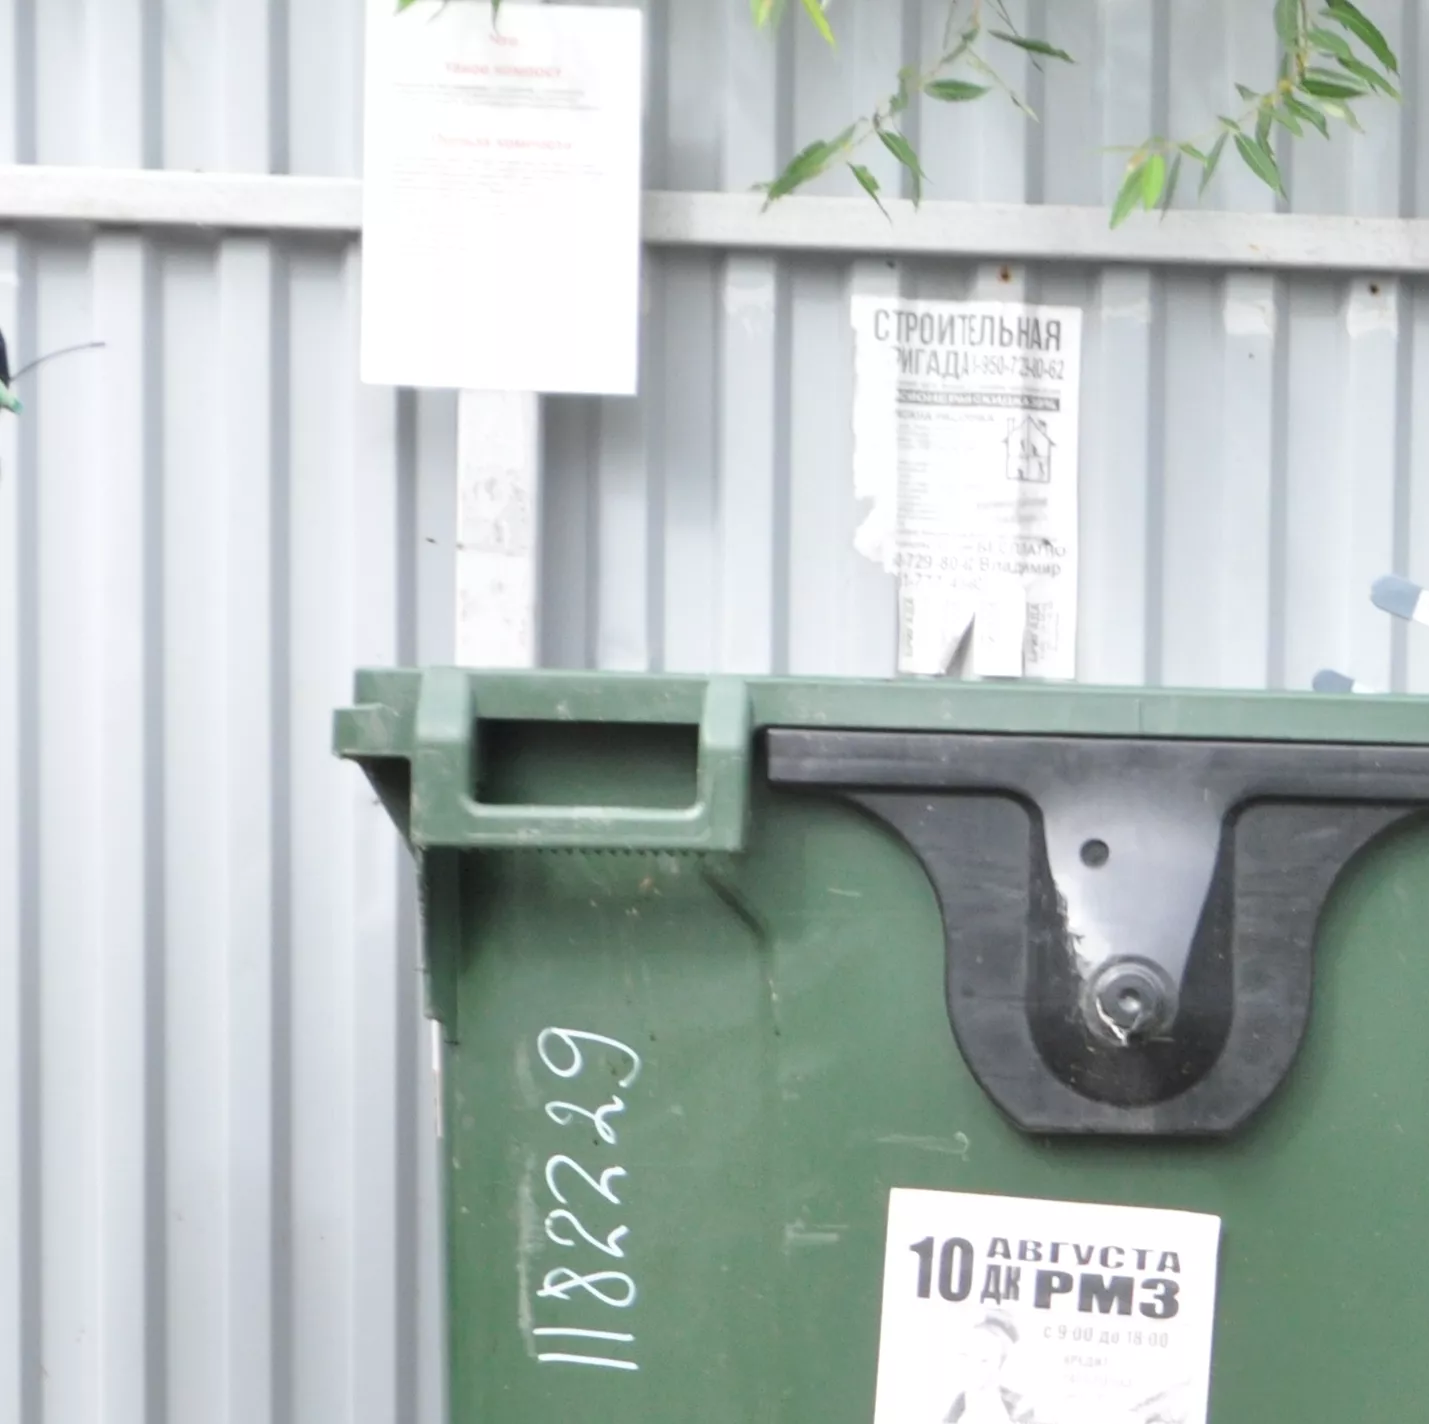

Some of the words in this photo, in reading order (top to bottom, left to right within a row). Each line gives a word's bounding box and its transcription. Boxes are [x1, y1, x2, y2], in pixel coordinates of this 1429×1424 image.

[874, 309, 1062, 351] СТРОИТЕЛЬНАЯ
[532, 1026, 641, 1371] 1182229
[909, 1236, 974, 1302] 10
[986, 1237, 1182, 1274] АВГУСТА
[980, 1264, 1021, 1305] ДК
[1033, 1268, 1180, 1320] РМЗ
